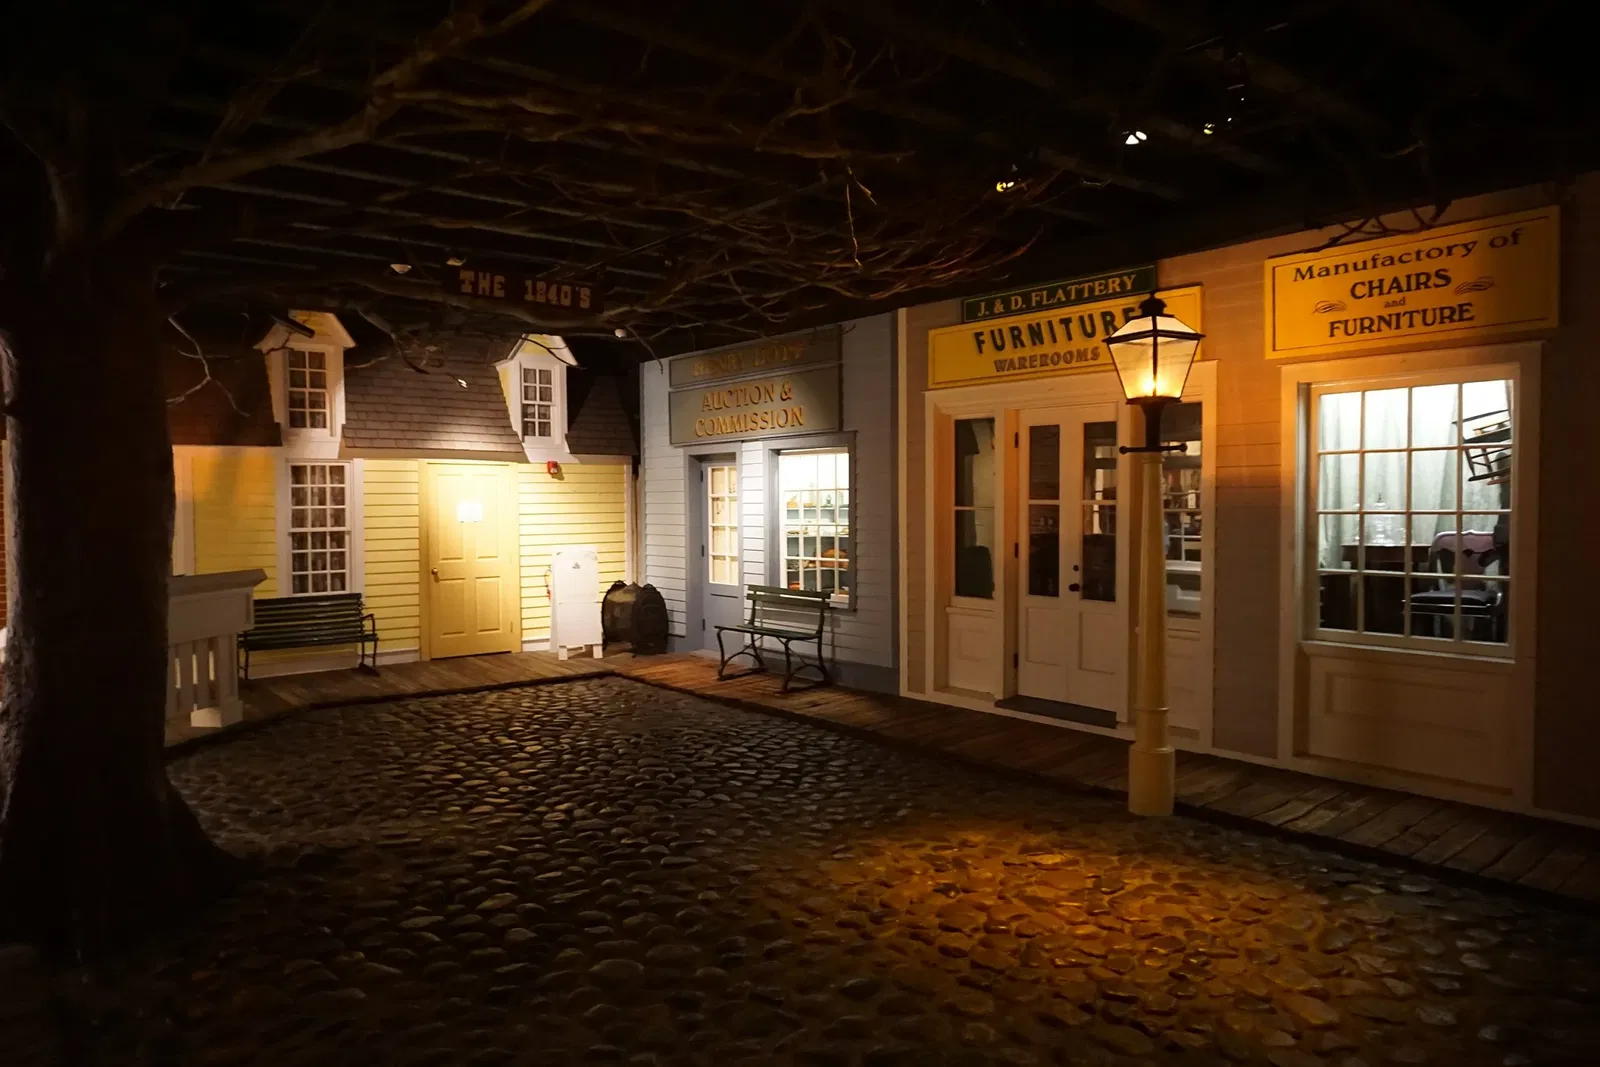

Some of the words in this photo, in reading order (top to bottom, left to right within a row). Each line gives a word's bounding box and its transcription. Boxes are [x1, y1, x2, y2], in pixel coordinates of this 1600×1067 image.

[1293, 240, 1478, 282] Manufactory
[1489, 228, 1524, 248] of
[460, 270, 505, 298] THE
[977, 302, 991, 317] J.
[993, 299, 1004, 314] &
[1007, 294, 1026, 311] D.
[1031, 274, 1137, 308] FLATTERY
[1350, 268, 1451, 300] CHAIRS
[1384, 297, 1406, 308] and
[1328, 302, 1475, 338] FURNITURE
[994, 345, 1100, 373] WAREROOMS
[701, 383, 774, 412] AUCTION
[780, 380, 793, 402] &
[695, 406, 804, 437] COMMISSION
